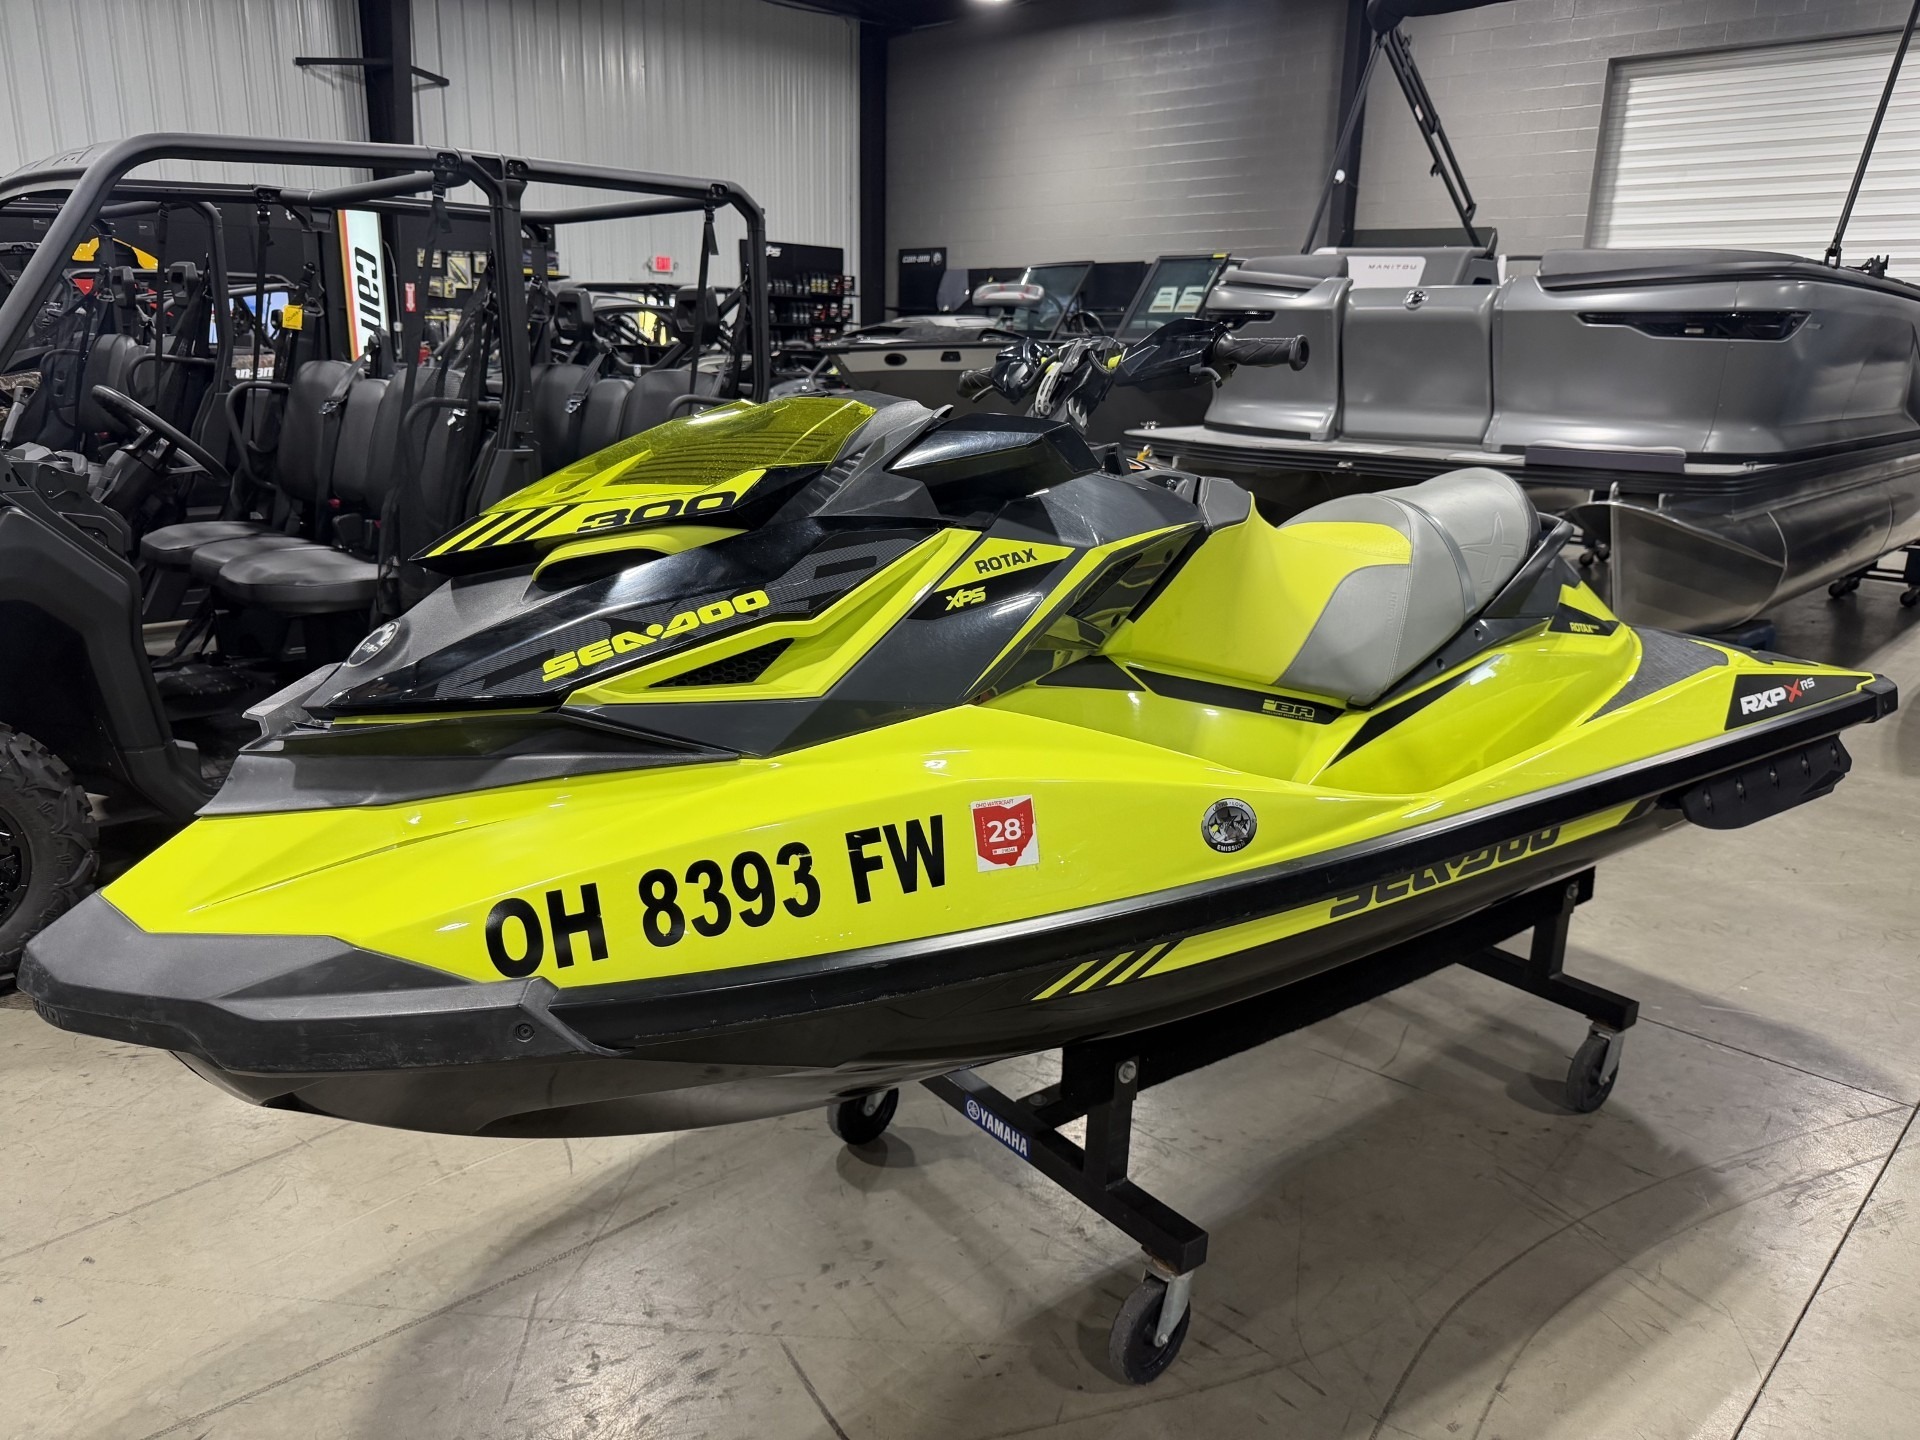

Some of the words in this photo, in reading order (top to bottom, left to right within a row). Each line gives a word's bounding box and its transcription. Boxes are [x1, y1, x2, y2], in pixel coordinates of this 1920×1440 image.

[577, 491, 737, 532] 300
[974, 548, 1038, 574] ROTAX
[945, 586, 986, 611] XPS
[986, 818, 1022, 843] 28
[485, 882, 609, 978] OH
[638, 841, 821, 948] 8393
[845, 814, 946, 904] FW
[980, 1108, 1028, 1157] YAMAHA
